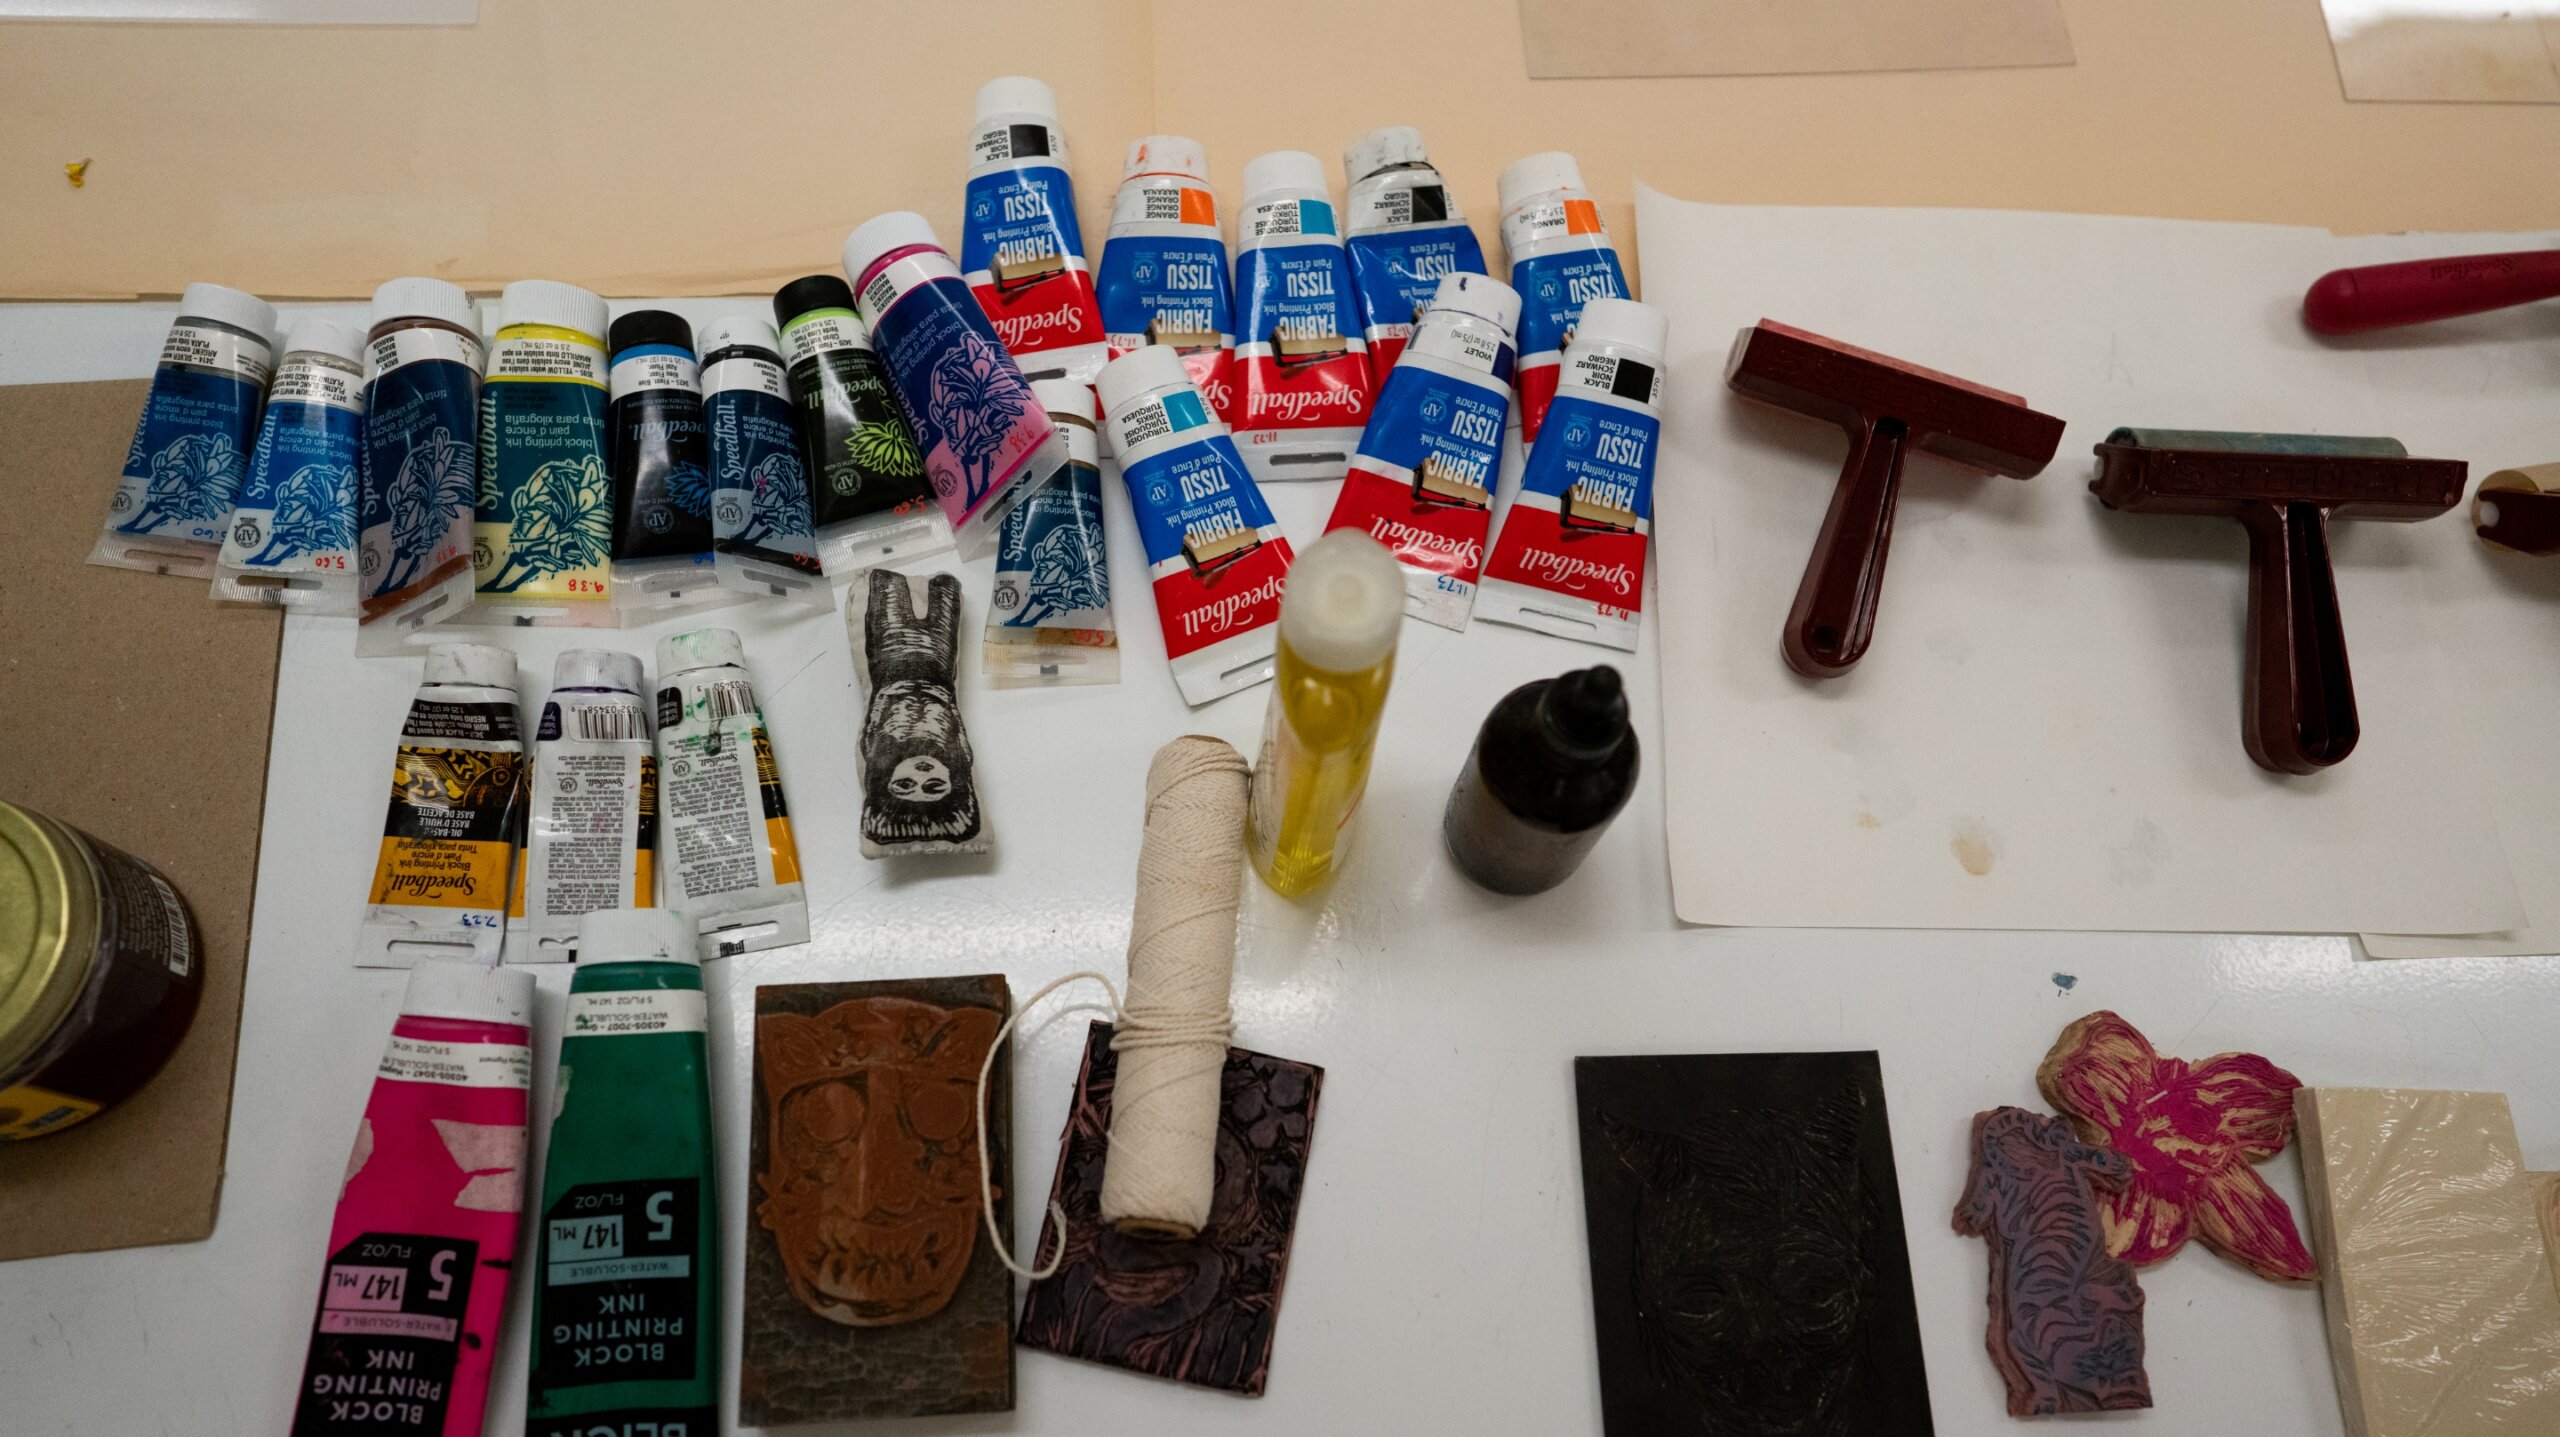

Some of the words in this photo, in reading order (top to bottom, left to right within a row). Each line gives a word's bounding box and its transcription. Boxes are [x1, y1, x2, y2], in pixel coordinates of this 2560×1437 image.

[983, 130, 1007, 139] NEGRO
[975, 137, 1007, 151] SCHWARZ
[991, 145, 1008, 153] NOIR
[986, 152, 1009, 161] BLACK
[1384, 192, 1409, 200] NEGRO
[1004, 192, 1047, 222] TISSU
[1374, 200, 1409, 209] SCHWARZ
[1146, 211, 1178, 219] ORANGE
[1032, 222, 1052, 234] Block
[1532, 218, 1565, 229] ORANGE
[983, 232, 995, 243] Ink
[998, 227, 1029, 240] Printing
[999, 234, 1054, 267] FABRIC
[1439, 242, 1455, 252] Pain
[1163, 252, 1192, 262] d'Encre
[1195, 253, 1213, 262] Pain
[1282, 260, 1311, 271] d'Encre
[1314, 259, 1332, 269] Pain
[1563, 265, 1591, 276] d'Encre
[1594, 263, 1611, 273] Pain
[1136, 266, 1152, 277] AP
[1167, 264, 1213, 289] TISSU
[866, 273, 886, 295] MAGENTA
[870, 279, 890, 300] MAGENTA
[1286, 271, 1334, 297] TISSU
[1568, 275, 1616, 303] TISSU
[873, 285, 894, 306] MAGENTA
[877, 291, 897, 313] MAGENTA
[1142, 297, 1155, 307] Ink
[1157, 295, 1189, 307] Printing
[1192, 297, 1213, 307] Block
[1264, 305, 1276, 315] Ink
[1279, 303, 1311, 313] Printing
[1313, 302, 1335, 312] Block
[919, 309, 939, 330] para
[1156, 309, 1212, 333] FABRIC
[1550, 313, 1563, 324] Ink
[920, 325, 937, 343] pain
[936, 321, 961, 343] block
[1280, 314, 1336, 341] FABRIC
[191, 339, 210, 347] PLATA
[173, 353, 192, 362] SILVER
[193, 348, 217, 357] ARGENT
[524, 350, 544, 359] soluble
[546, 351, 559, 359] tinta
[909, 341, 936, 366] printing
[1464, 347, 1492, 362] VIOLET
[1588, 355, 1616, 365] NEGRO
[509, 366, 529, 374] soluble
[548, 366, 573, 374] YELLOW
[1576, 361, 1614, 373] SCHWARZ
[1591, 371, 1612, 381] NOIR
[764, 385, 778, 393] BLACK
[1584, 378, 1610, 390] BLACK
[1251, 384, 1363, 420] Speedball
[1456, 396, 1485, 415] d'Encre
[1121, 403, 1162, 423] TURQUESA
[1424, 403, 1442, 417] AP
[1486, 407, 1502, 422] Pain
[153, 414, 166, 422] ink
[169, 414, 200, 425] printing
[202, 420, 223, 428] block
[556, 414, 579, 424] para
[550, 426, 570, 436] pain
[1124, 418, 1167, 440] TURQUOISE
[1450, 410, 1499, 447] TISSU
[1599, 420, 1629, 437] d'Encre
[1631, 428, 1648, 442] Pain
[525, 436, 562, 448] printing
[1127, 426, 1170, 447] TURQUOISE
[1253, 432, 1277, 444] 11.73
[1420, 433, 1434, 449] Ink
[1567, 429, 1585, 442] AP
[277, 445, 289, 453] ink
[292, 444, 325, 454] printing
[314, 439, 334, 448] pain
[373, 440, 387, 450] ink
[506, 438, 521, 447] ink
[565, 439, 592, 448] block
[713, 404, 746, 481] Speedball
[1435, 437, 1467, 456] Printing
[246, 414, 277, 500] Speedball
[329, 450, 352, 461] block
[1470, 449, 1492, 464] Block
[1596, 433, 1641, 469] TISSU
[1171, 458, 1200, 474] d'Encre
[1202, 454, 1221, 466] Pain
[1566, 460, 1580, 473] Ink
[1426, 450, 1487, 488] FABRIC
[1582, 461, 1615, 480] Printing
[1180, 465, 1230, 502] TISSU
[1617, 472, 1638, 487] Block
[1152, 484, 1166, 500] AP
[1573, 476, 1634, 513] FABRIC
[893, 495, 926, 515] 5.60
[1214, 496, 1236, 509] Block
[1044, 505, 1074, 515] printing
[1181, 504, 1213, 520] Printing
[1166, 513, 1181, 527] Ink
[1186, 508, 1245, 548] FABRIC
[1369, 516, 1483, 569] Speedball
[315, 556, 344, 569] 5.60
[1520, 547, 1635, 595] Speedball
[569, 579, 603, 592] 9.38
[1437, 575, 1467, 596] 11.73
[1183, 576, 1287, 636] Speedball
[418, 808, 444, 817] ACEITE
[419, 818, 449, 827] D'HUILE
[451, 820, 470, 828] BASE
[459, 844, 477, 854] Tinta
[444, 853, 461, 861] Pain
[399, 860, 412, 868] Ink
[414, 860, 445, 869] Printing
[448, 862, 471, 871] Block
[391, 873, 476, 898] Speedball
[461, 914, 496, 928] 7.23
[590, 1012, 668, 1022] WATER-SOLUBLE
[608, 1022, 666, 1031] 40305-7007
[413, 1071, 468, 1081] 40305-3047
[574, 1193, 624, 1208] FL/OZ
[645, 1191, 673, 1241] 5
[552, 1226, 576, 1240] ML
[582, 1222, 619, 1249] 147
[361, 1243, 411, 1258] FL/OZ
[428, 1249, 456, 1300] 5
[570, 1262, 669, 1277] WATER-SOLUBLE
[334, 1273, 358, 1287] ML
[361, 1275, 399, 1300] 147
[598, 1293, 645, 1314] INK
[344, 1318, 440, 1331] WATER-SOLUBLE
[553, 1318, 682, 1344] PRINTING
[365, 1350, 414, 1370] INK
[574, 1342, 664, 1367] BLOCK
[313, 1374, 441, 1401] PRINTING
[329, 1401, 423, 1424] BLOCK
